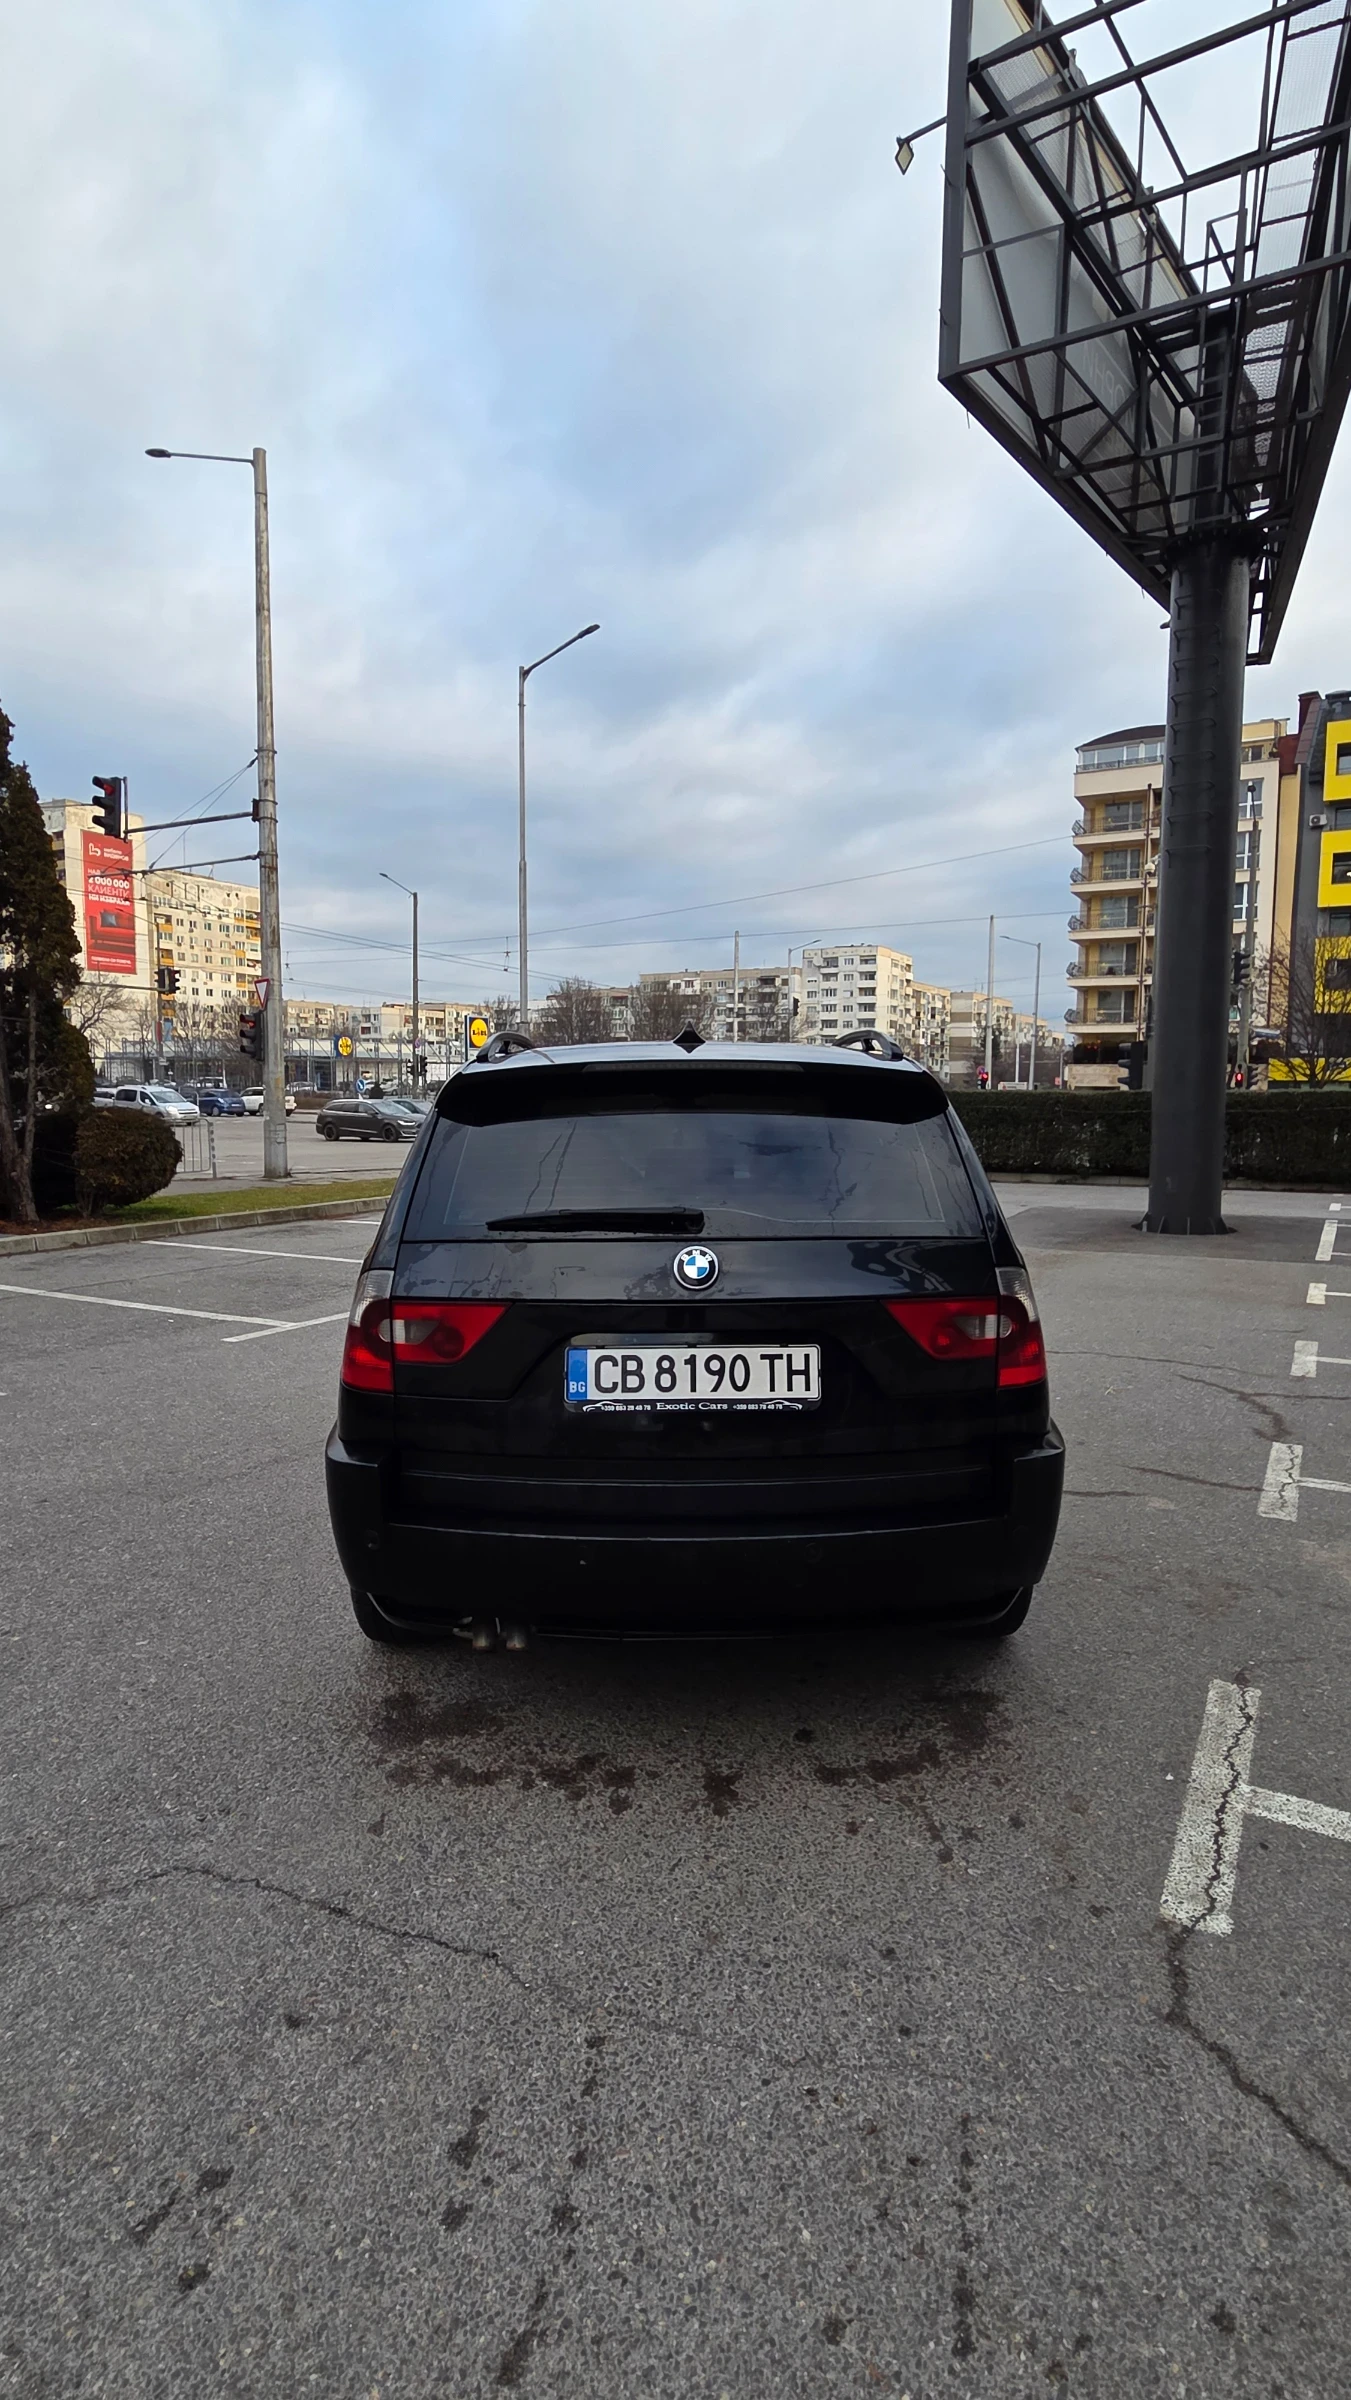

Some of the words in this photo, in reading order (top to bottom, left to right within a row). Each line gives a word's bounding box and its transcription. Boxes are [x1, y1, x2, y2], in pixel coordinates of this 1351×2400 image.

[94, 876, 112, 887] 000
[113, 879, 130, 889] 000
[594, 1354, 645, 1393] CB
[654, 1353, 751, 1393] 8190
[760, 1353, 811, 1392] TH
[569, 1380, 586, 1393] BG
[656, 1402, 696, 1410] Exotic
[698, 1402, 728, 1410] Cars
